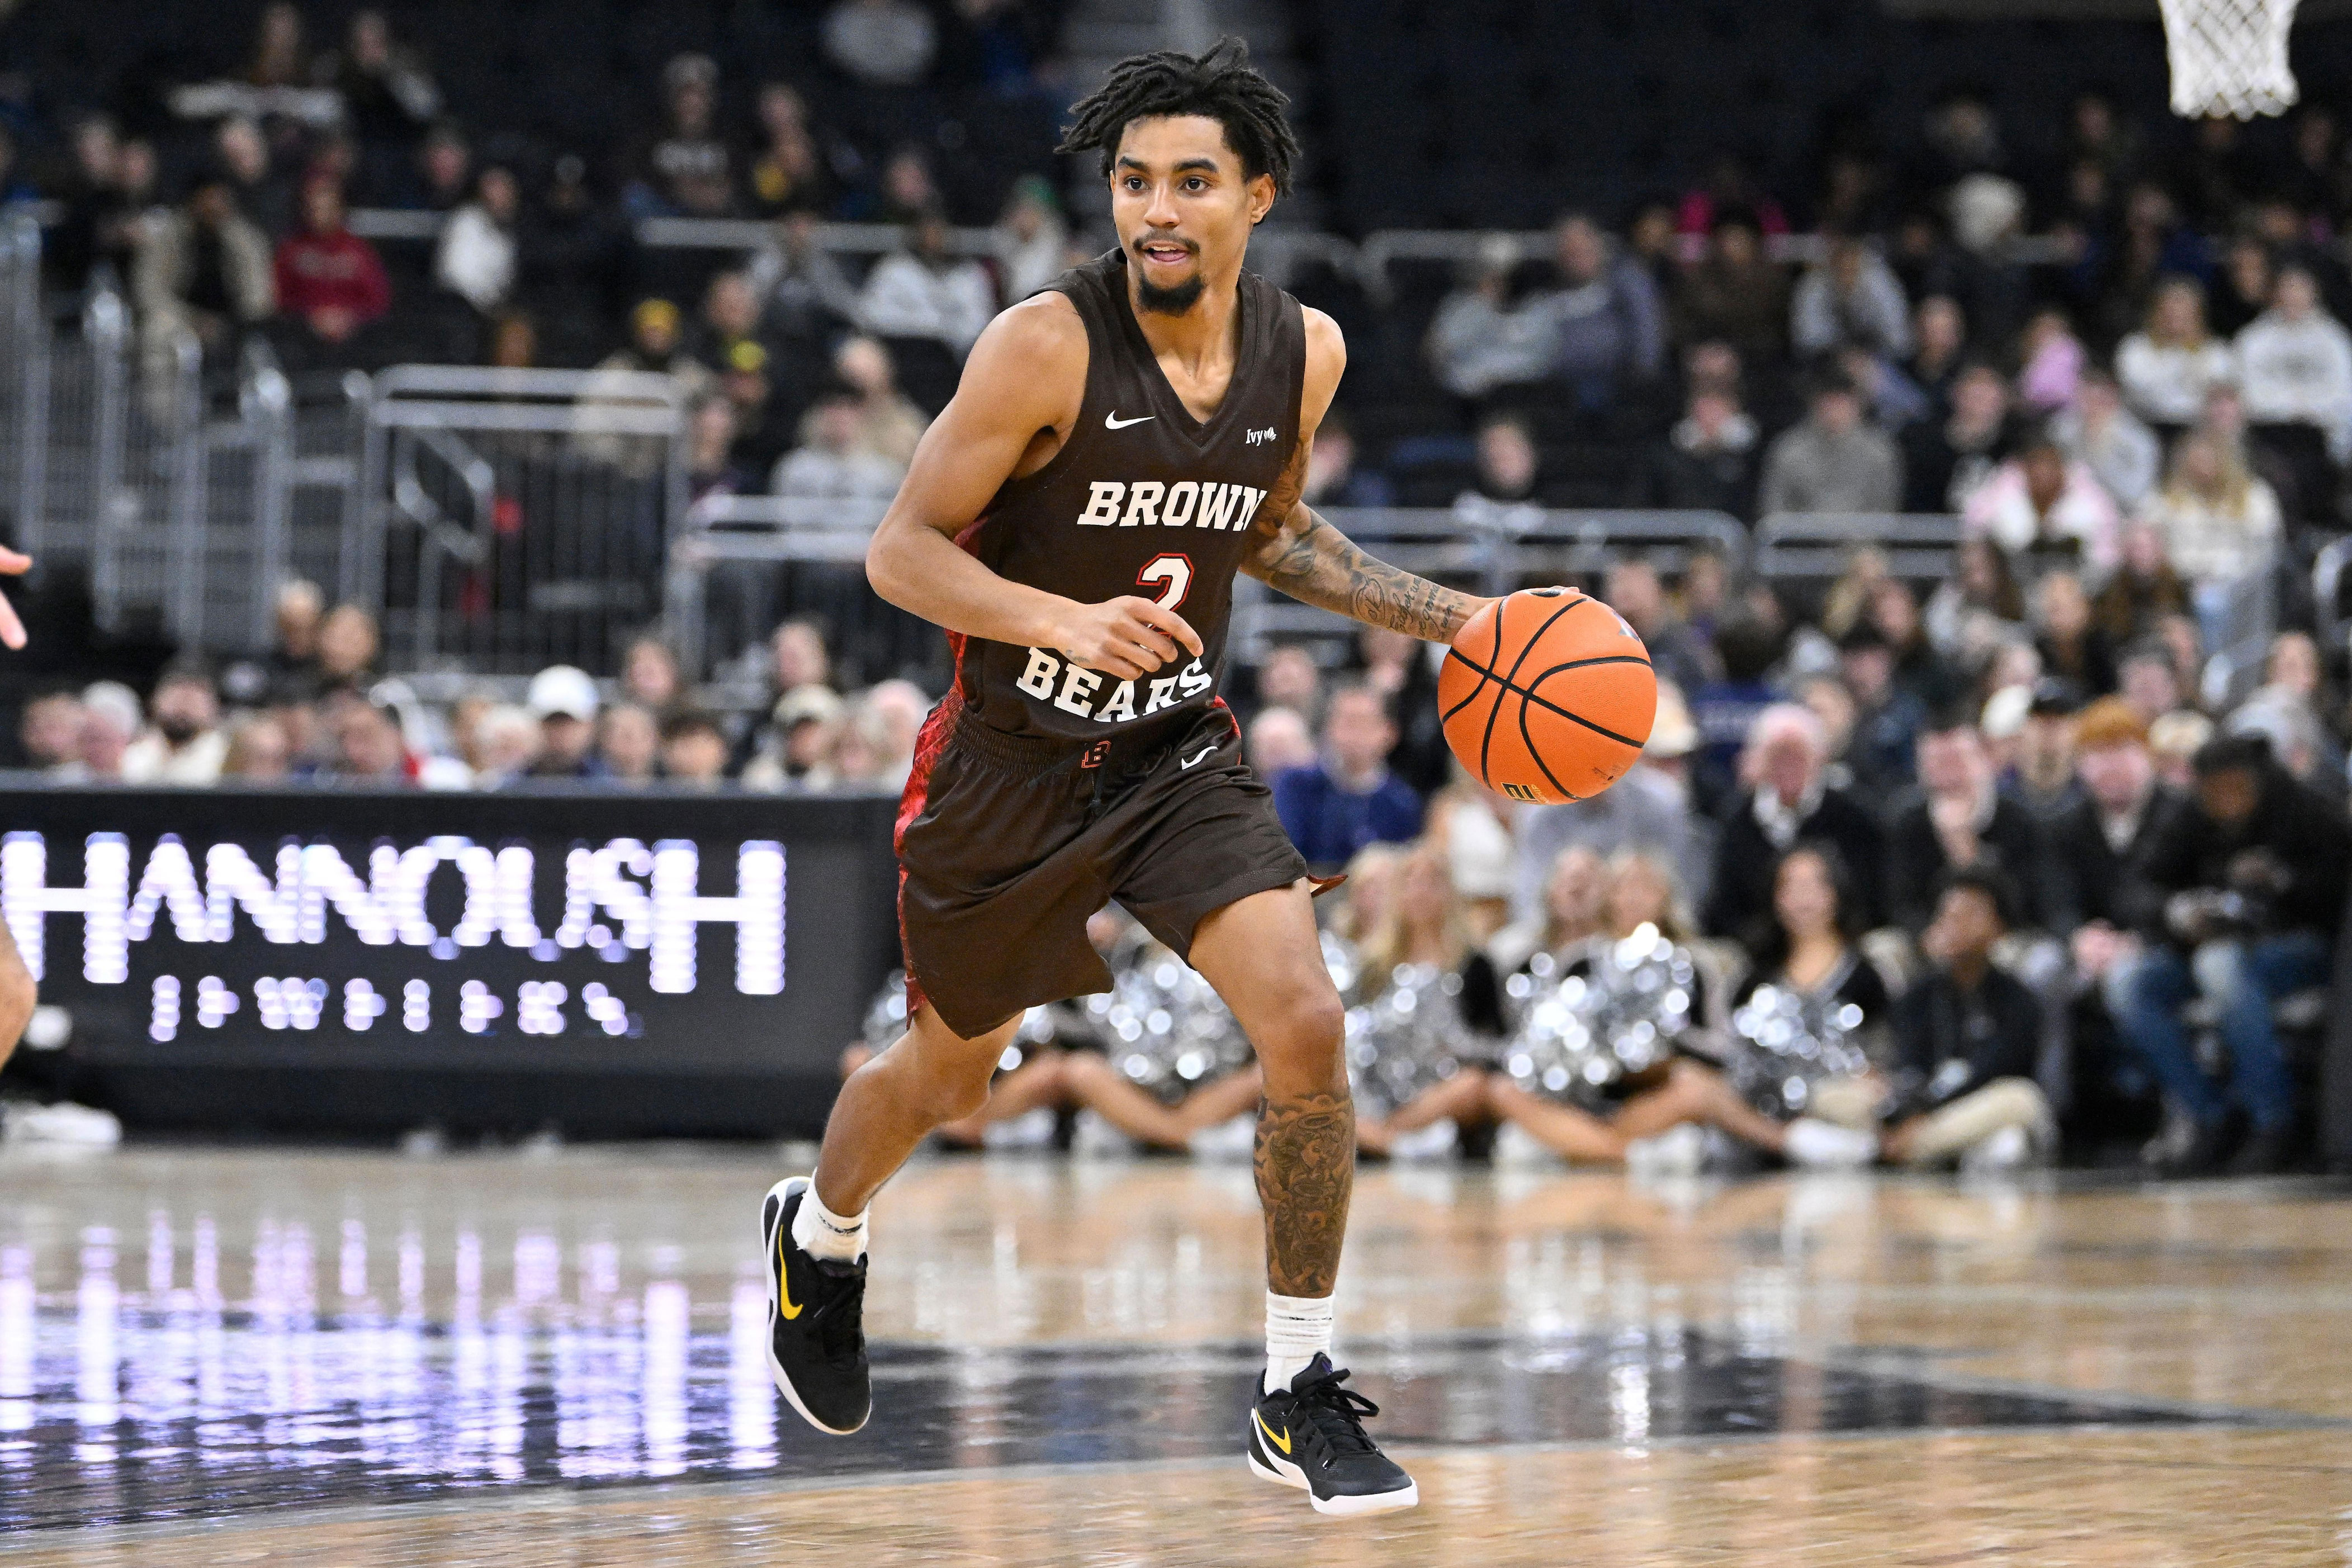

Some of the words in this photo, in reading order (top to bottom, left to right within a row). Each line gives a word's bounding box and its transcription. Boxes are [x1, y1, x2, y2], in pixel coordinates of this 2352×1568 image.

[1246, 428, 1263, 447] Ivy
[1077, 481, 1267, 531] BROWN
[1016, 647, 1212, 722] BEARS
[1081, 740, 1111, 768] B
[0, 831, 785, 994] HANNOUSH
